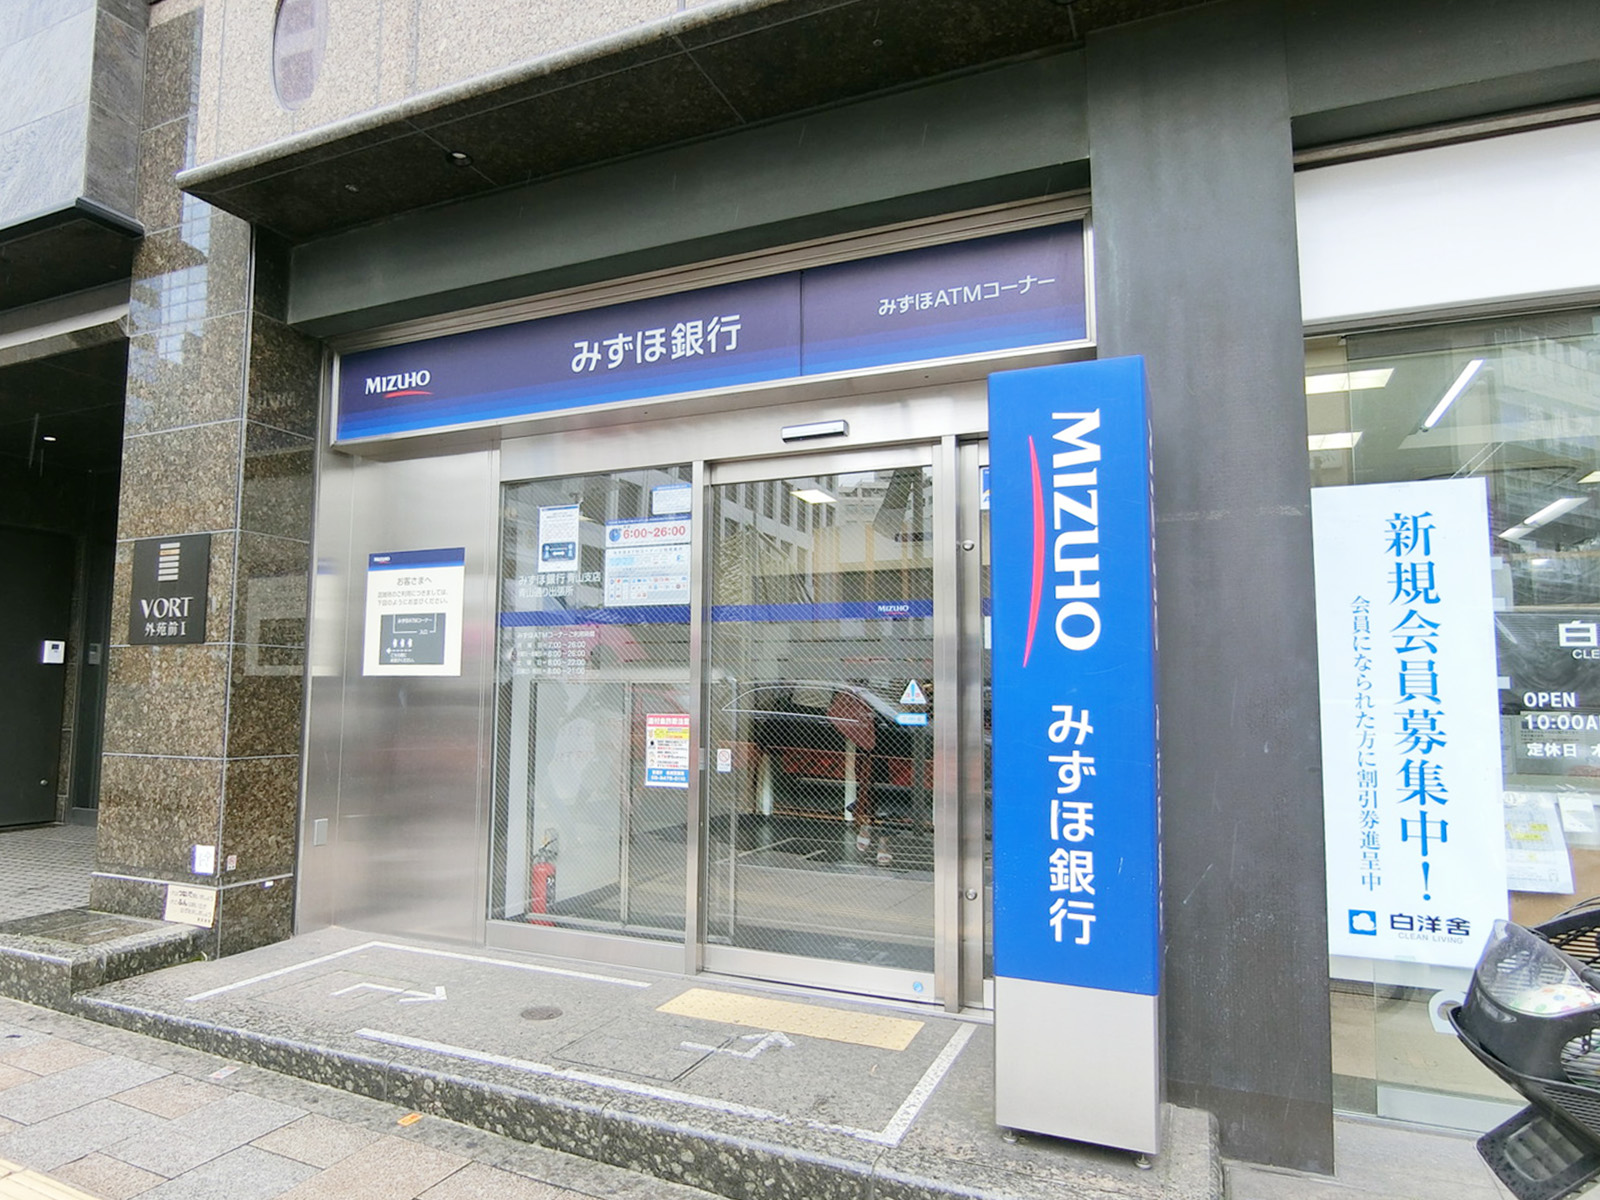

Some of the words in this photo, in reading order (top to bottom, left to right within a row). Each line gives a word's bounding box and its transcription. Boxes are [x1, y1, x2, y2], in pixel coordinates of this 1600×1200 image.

[878, 275, 1056, 316] みずほATMコーナー
[571, 314, 742, 373] みずほ銀行
[365, 369, 431, 395] MIZUHO
[1051, 408, 1101, 651] MIZUHO
[397, 576, 432, 587] お客さまへ
[141, 597, 194, 619] VORT
[878, 604, 909, 612] MIZUHO
[1384, 511, 1449, 901] 新規会員募集中！
[1523, 692, 1576, 707] OPEN
[1525, 714, 1600, 730] 10:00A
[1351, 595, 1381, 891] 会員になられた方に割引券進呈中
[1527, 743, 1577, 758] 定休日
[1048, 705, 1097, 945] みずほ銀行
[1398, 932, 1429, 941] CLEAN
[1432, 936, 1464, 945] LIVING
